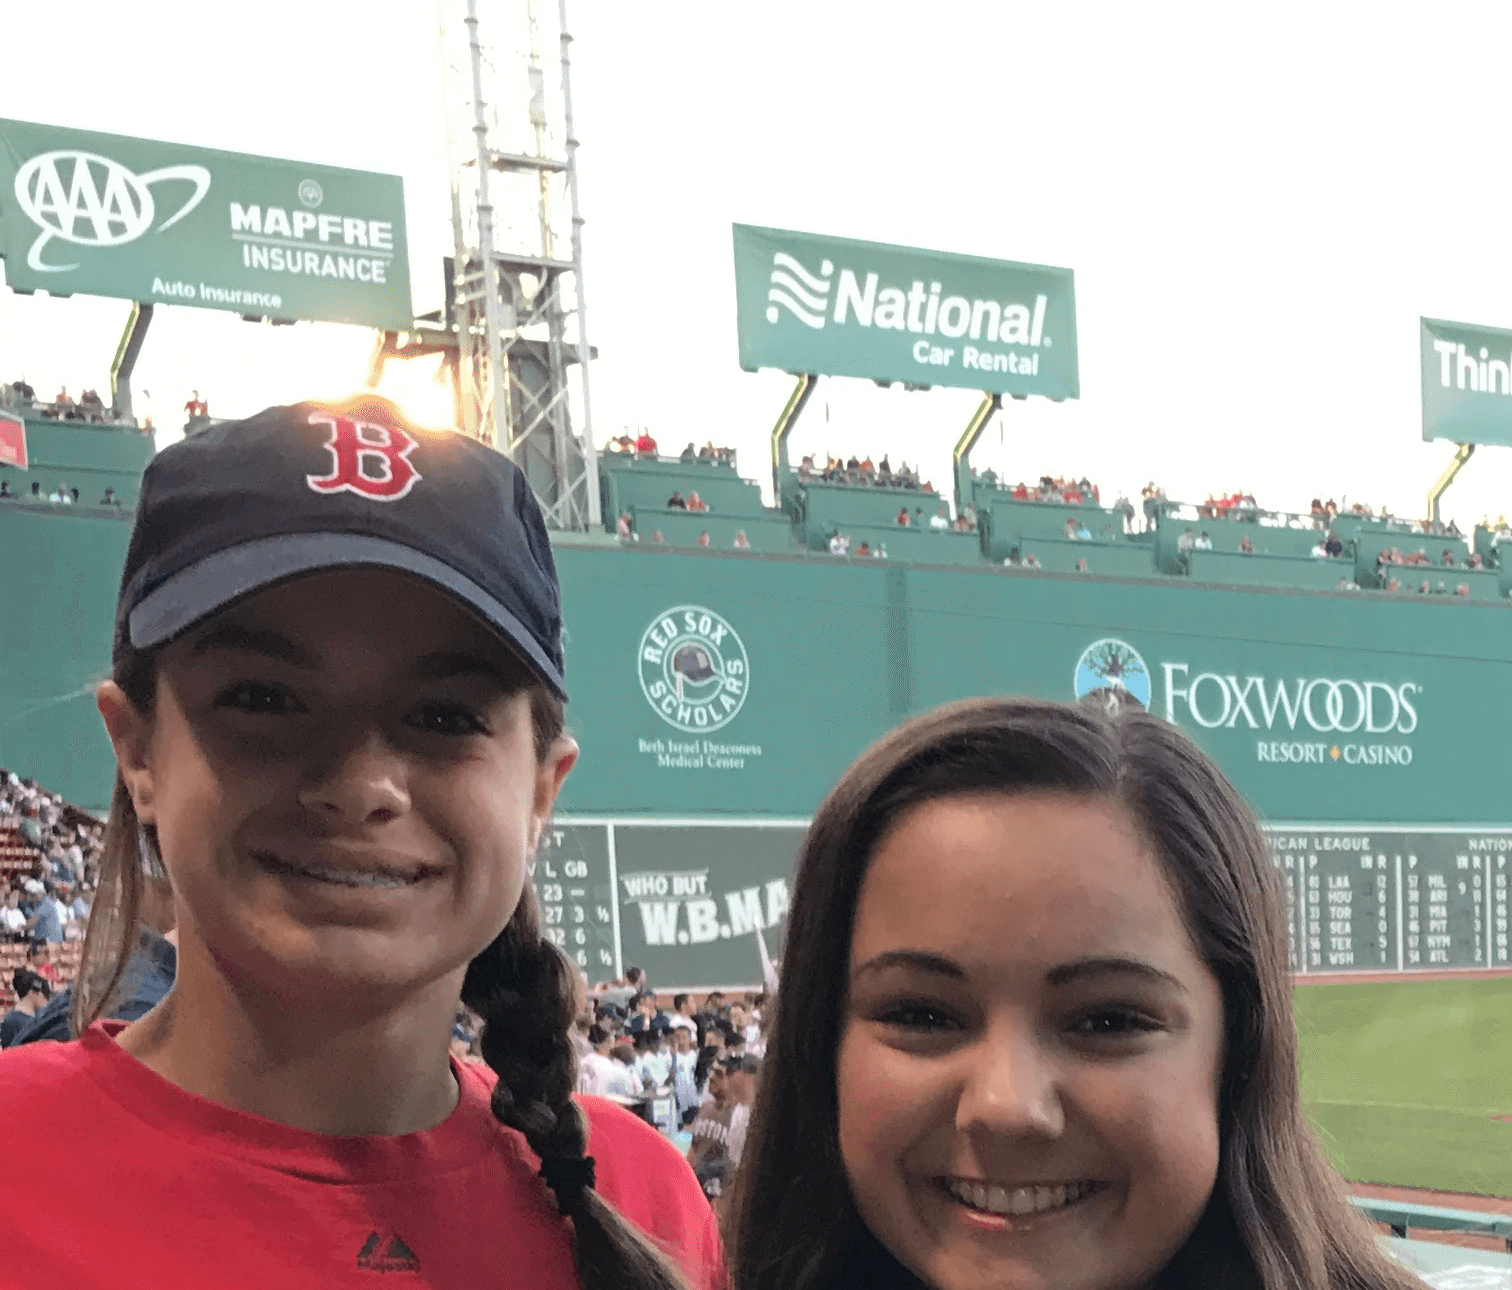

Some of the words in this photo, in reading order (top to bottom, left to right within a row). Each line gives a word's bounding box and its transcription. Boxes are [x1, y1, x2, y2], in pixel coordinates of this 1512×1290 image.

[33, 155, 142, 244] AAA
[230, 203, 393, 250] MAPFRE
[243, 244, 391, 284] INSURANCE
[152, 277, 196, 300] Auto
[200, 282, 281, 309] Insurance
[833, 269, 1048, 347] National
[912, 341, 954, 367] Car
[963, 346, 1039, 377] Rental
[307, 411, 422, 503] B
[643, 617, 678, 665] RED
[684, 611, 728, 646] SOX
[650, 658, 744, 727] SCHOLARS
[1161, 661, 1418, 734] FOXWOODS
[638, 738, 664, 753] Beth
[668, 740, 700, 754] Israel
[1257, 741, 1325, 764] RESORT
[1343, 745, 1413, 766] CASINO
[658, 754, 704, 768] Medical
[707, 756, 744, 769] Center
[1314, 837, 1370, 851] LEAGUE
[565, 860, 588, 878] GB
[1377, 855, 1387, 869] R
[543, 884, 563, 902] 23
[624, 875, 668, 897] WHO
[673, 875, 707, 896] BUT
[545, 906, 563, 924] 27
[574, 906, 584, 924] 3
[575, 928, 586, 945] 6
[576, 949, 587, 967] 6
